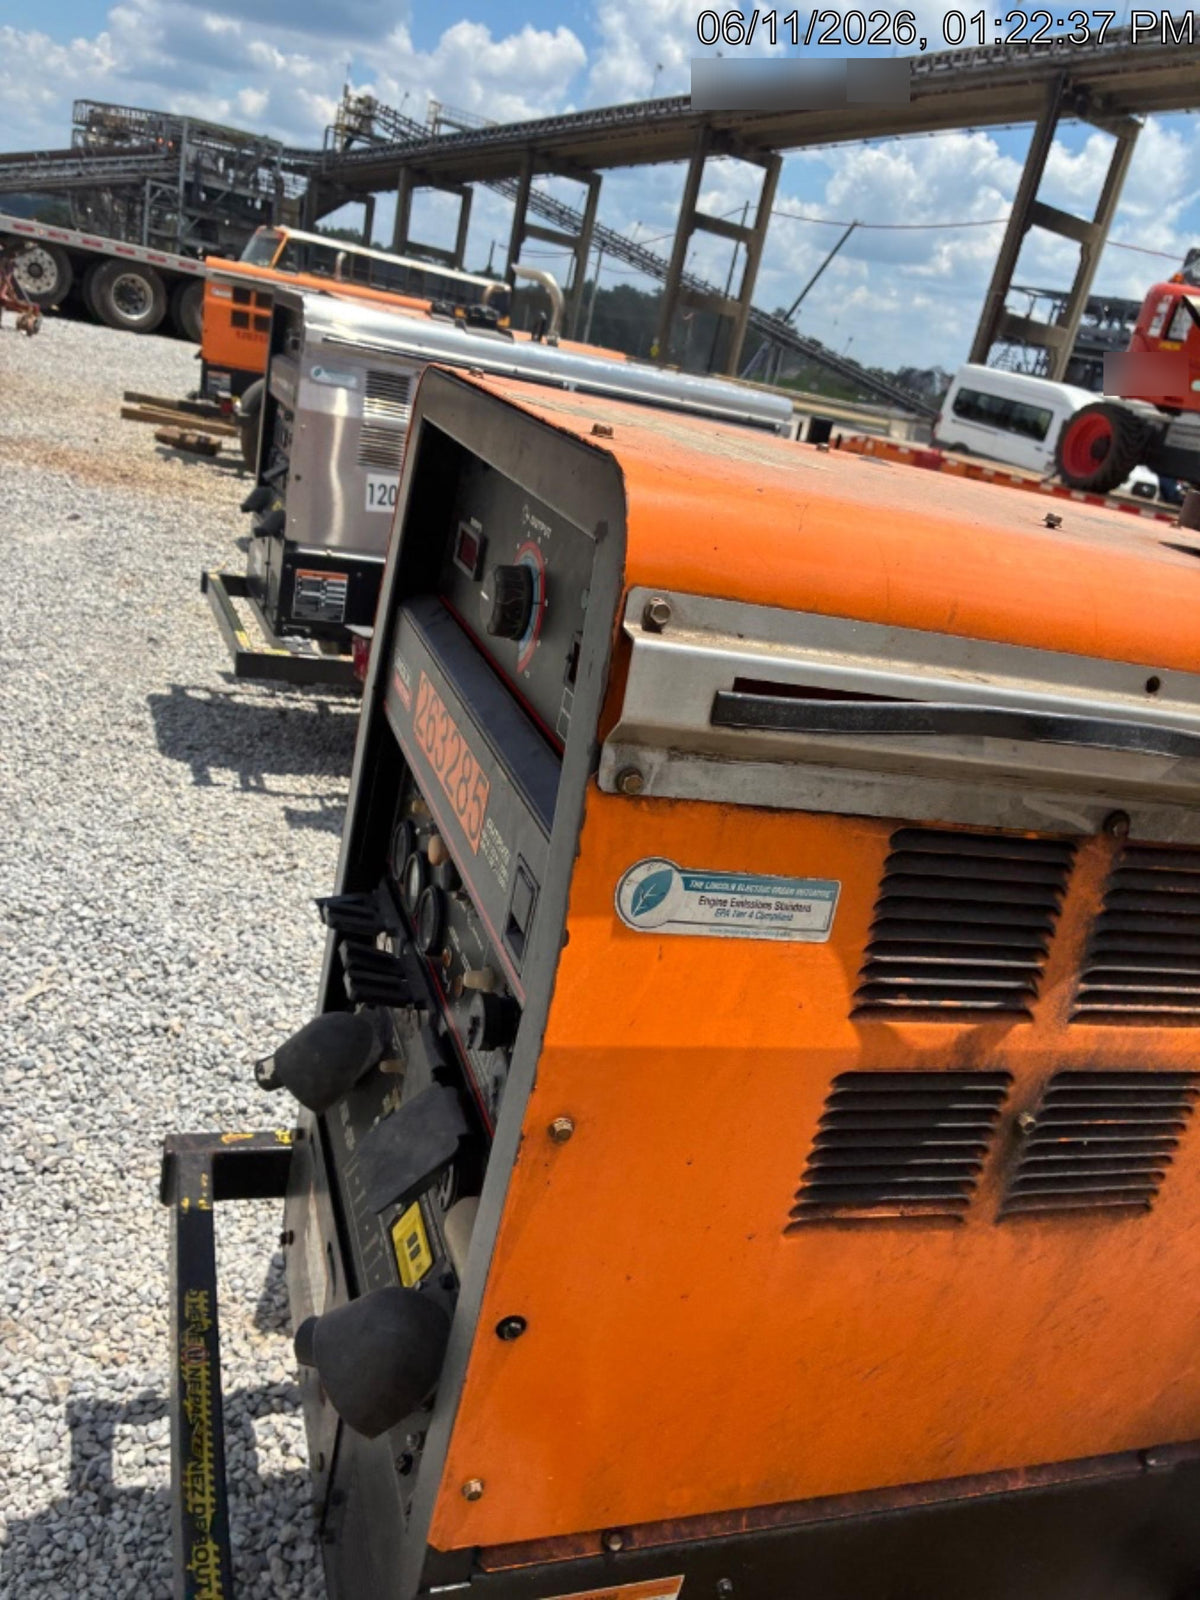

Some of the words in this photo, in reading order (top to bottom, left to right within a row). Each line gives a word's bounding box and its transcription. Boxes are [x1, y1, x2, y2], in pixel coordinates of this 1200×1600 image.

[415, 679, 488, 842] 263285
[698, 895, 727, 909] Engine
[730, 897, 773, 911] Emissions
[775, 900, 812, 913] Standard
[755, 911, 793, 923] Compliant
